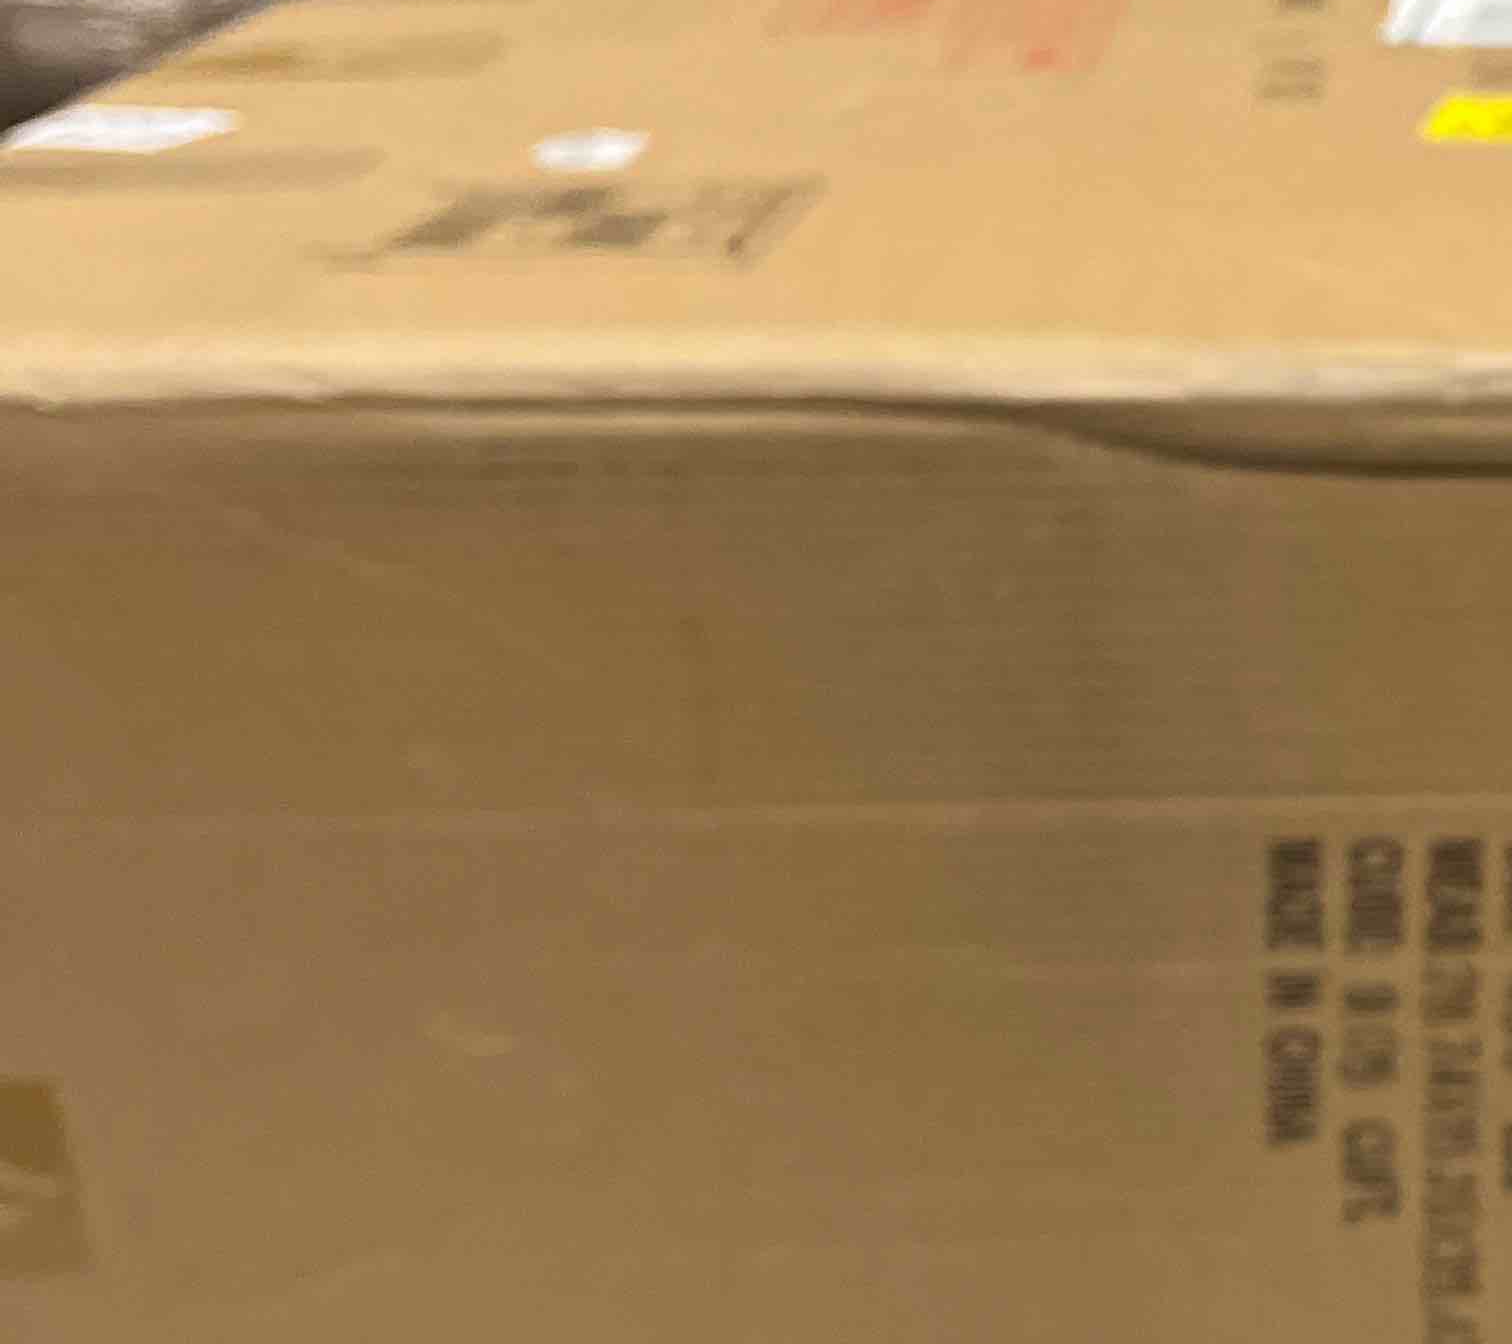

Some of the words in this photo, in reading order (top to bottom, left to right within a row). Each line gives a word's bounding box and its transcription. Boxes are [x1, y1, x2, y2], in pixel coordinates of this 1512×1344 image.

[1265, 838, 1323, 951] MADE
[1267, 974, 1320, 1011] IN
[1266, 1029, 1320, 1147] CHINA
